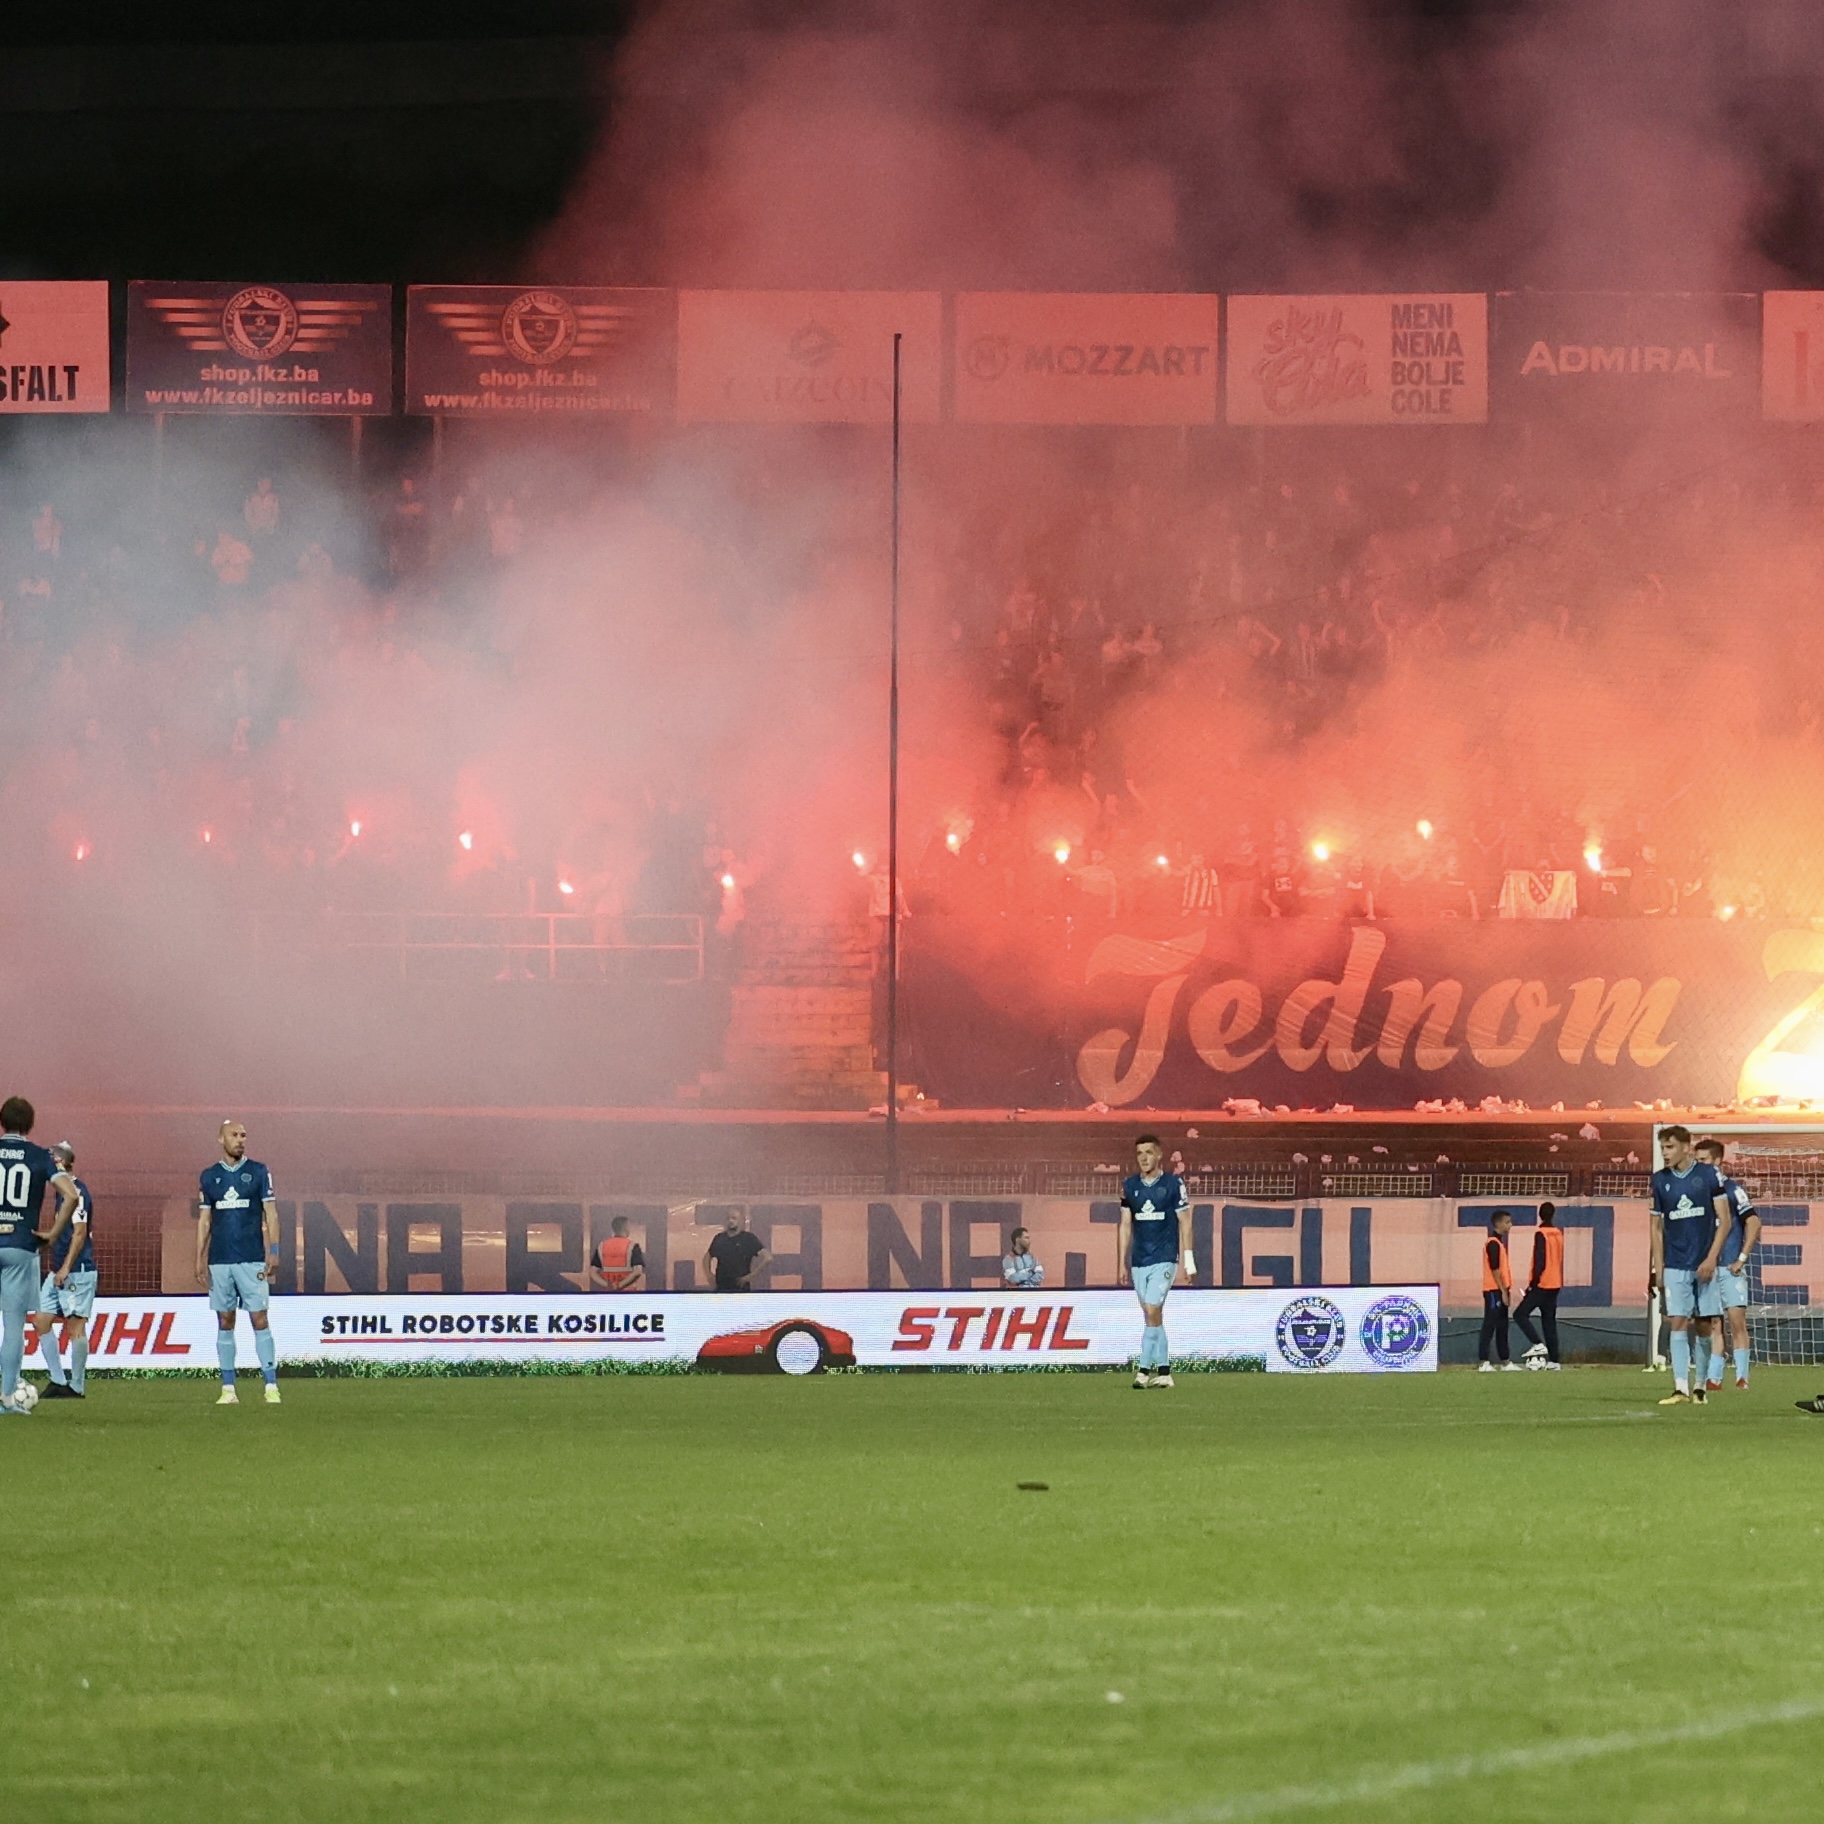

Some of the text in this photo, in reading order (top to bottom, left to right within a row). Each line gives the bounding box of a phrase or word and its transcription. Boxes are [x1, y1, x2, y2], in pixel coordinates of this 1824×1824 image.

[1390, 303, 1454, 330] MENI
[1390, 330, 1464, 358] NEMA
[1022, 343, 1210, 377] MOZZART
[1390, 359, 1465, 386] BOLJE
[1521, 340, 1732, 378] ADMIRAL
[200, 364, 320, 385] shop.fkz.ba
[1390, 388, 1453, 414] COLE
[1075, 925, 1680, 1108] Jednom
[320, 1313, 665, 1335] STIHL ROBOTSKE KOSILICE
[890, 1305, 1093, 1353] STIHL
